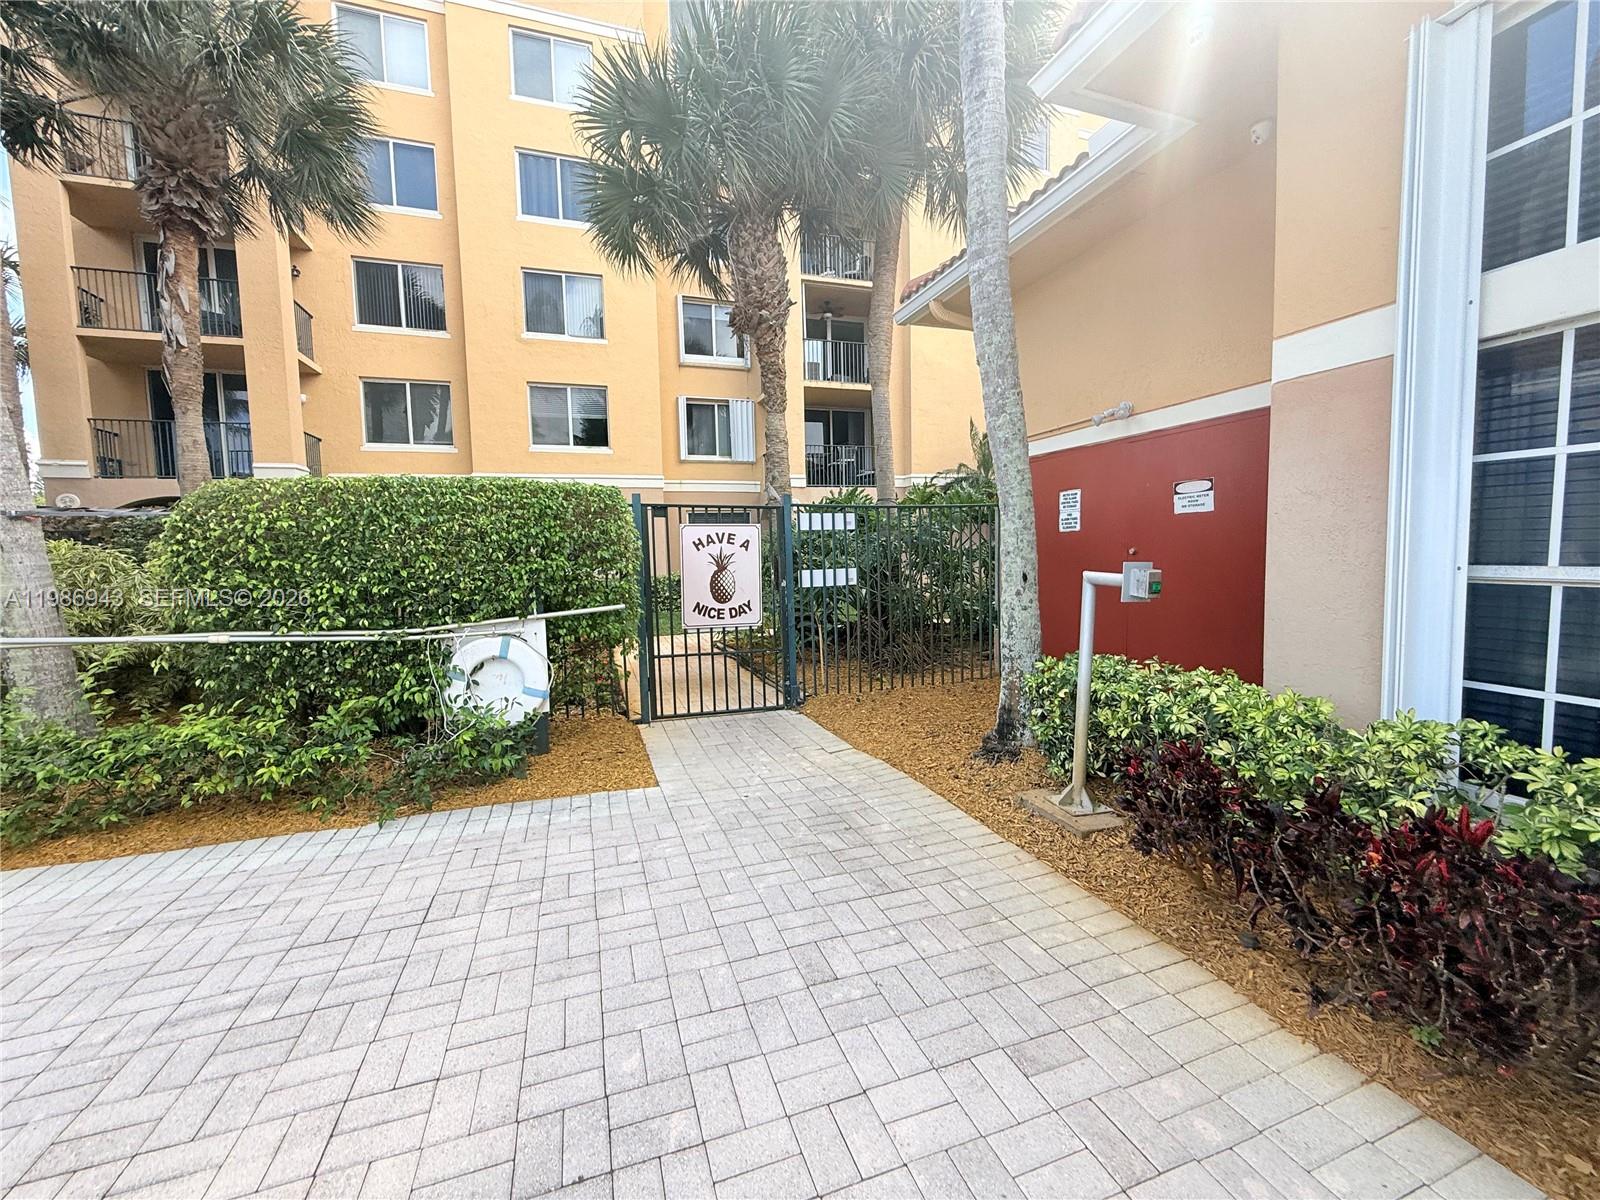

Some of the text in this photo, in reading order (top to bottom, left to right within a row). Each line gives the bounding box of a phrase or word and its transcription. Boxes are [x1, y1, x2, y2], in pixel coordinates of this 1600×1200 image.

[691, 532, 751, 552] HAVE A
[692, 599, 753, 620] NICE DAY
